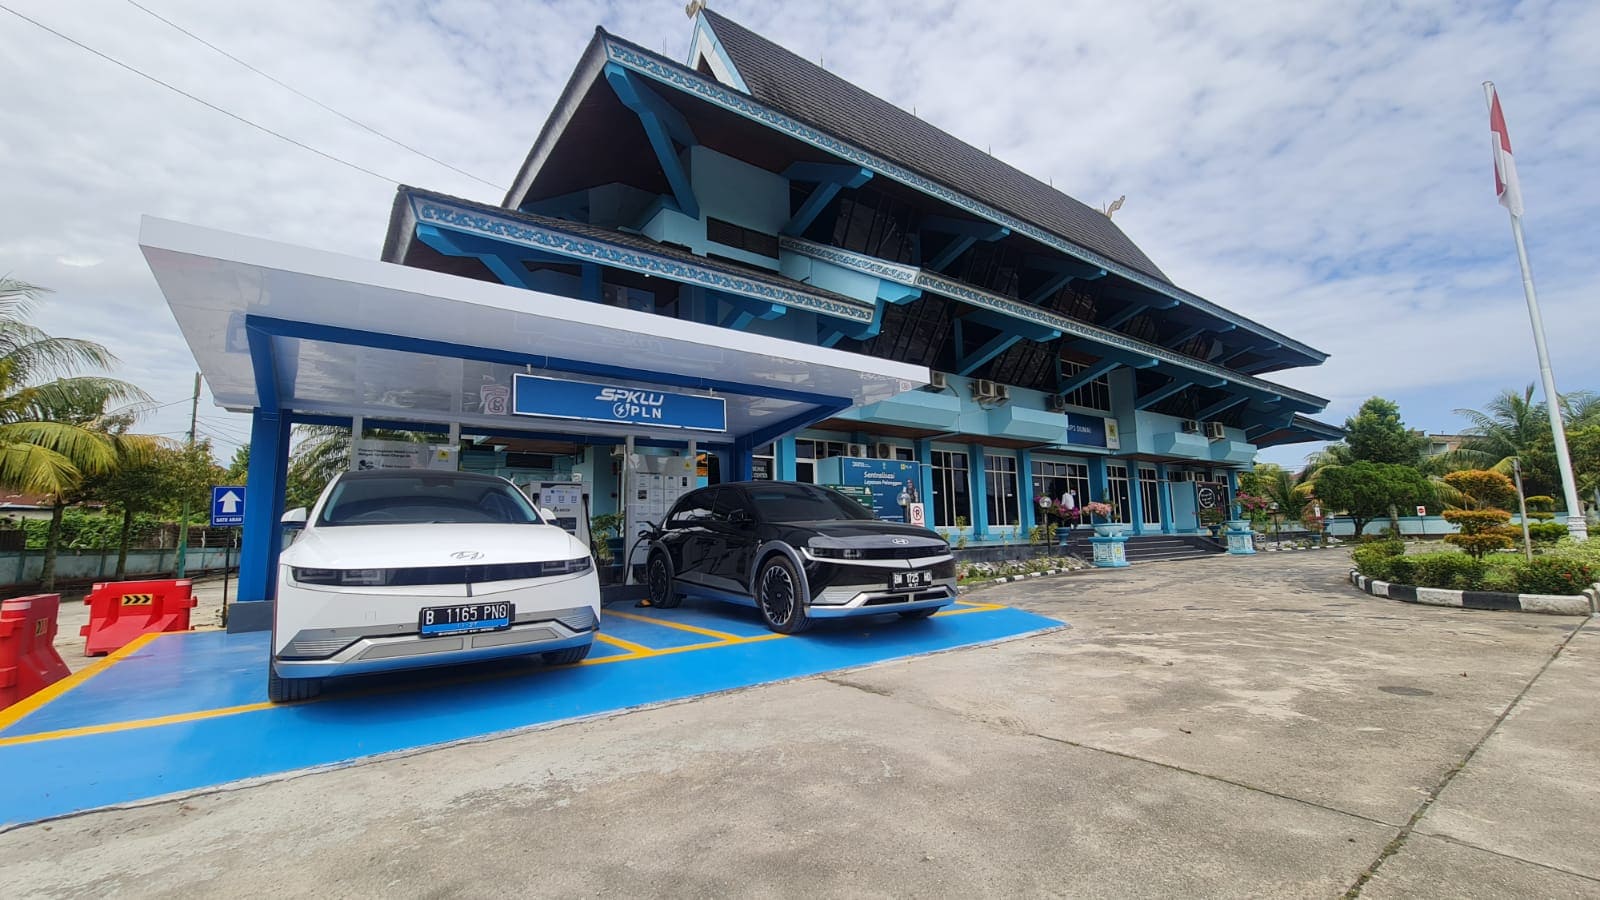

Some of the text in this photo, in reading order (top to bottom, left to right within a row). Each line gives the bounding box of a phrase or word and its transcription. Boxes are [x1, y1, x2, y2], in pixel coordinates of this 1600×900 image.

[595, 387, 664, 406] SPKLU
[631, 405, 662, 419] PLN
[863, 471, 896, 479] Sentralisasi
[906, 572, 919, 584] 1725
[426, 610, 434, 625] B
[446, 606, 478, 623] 1165
